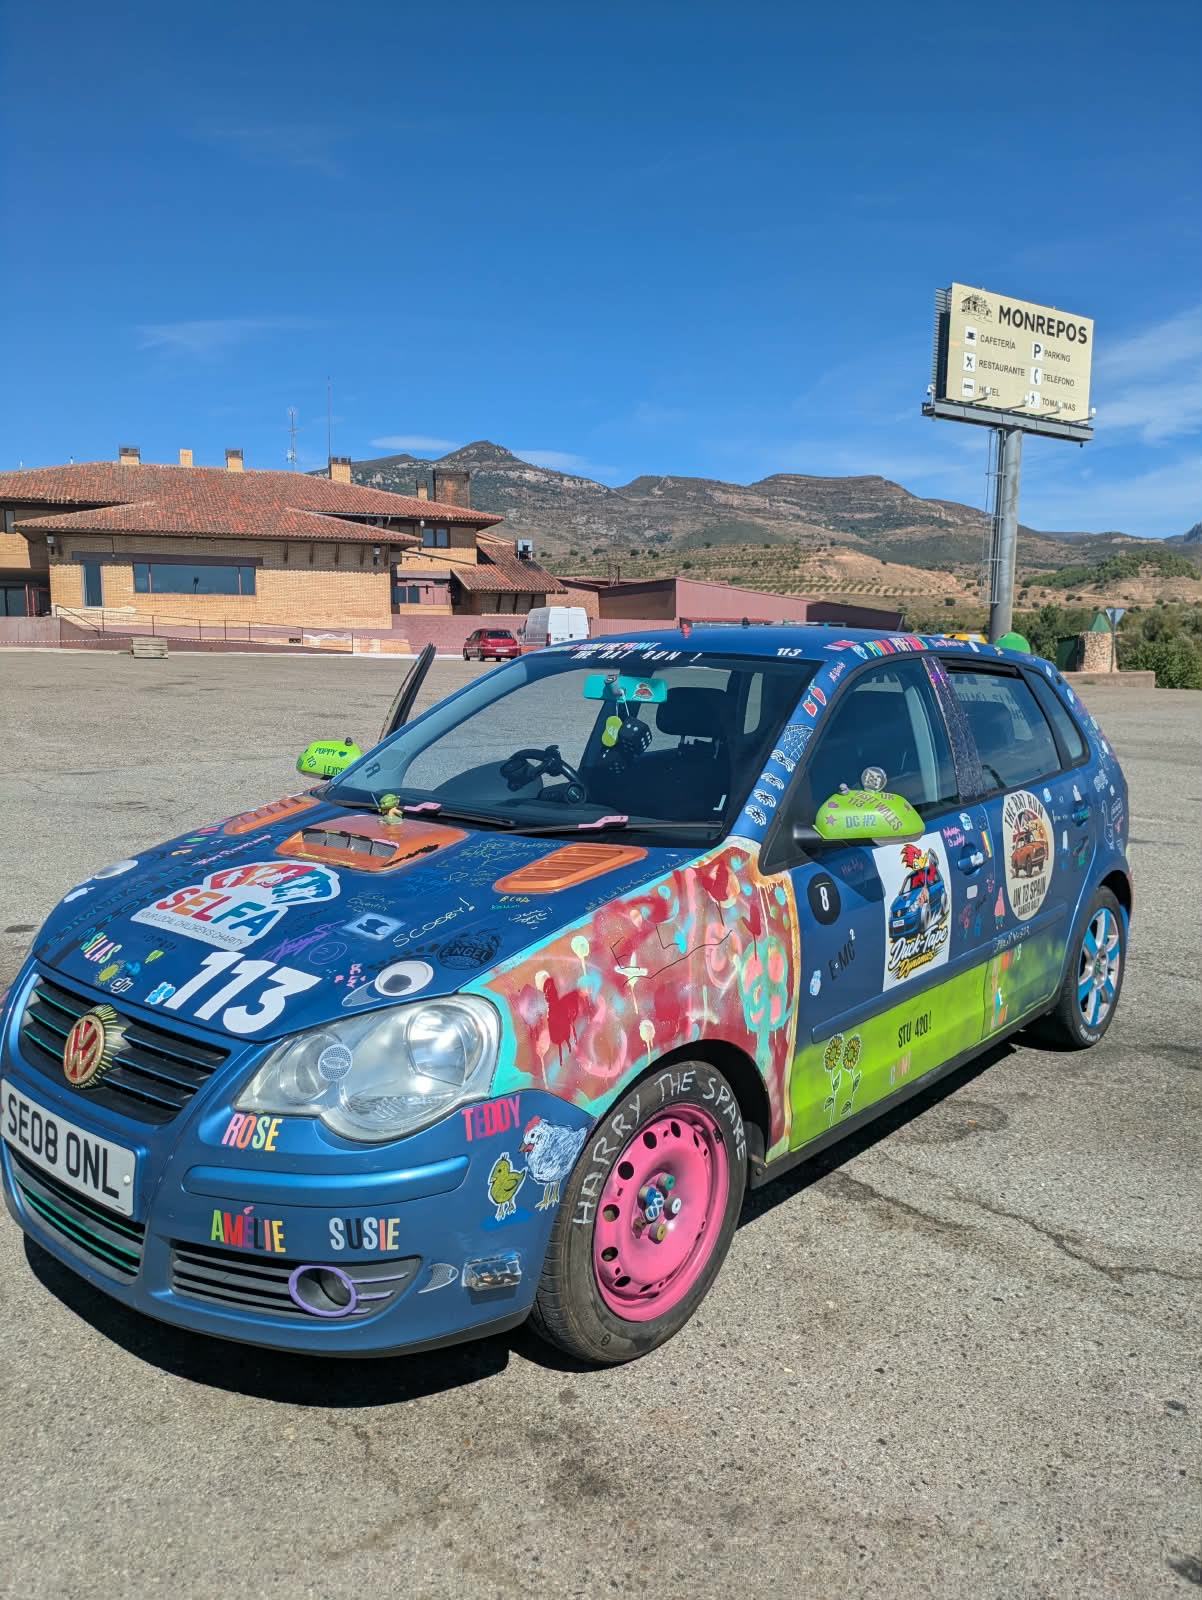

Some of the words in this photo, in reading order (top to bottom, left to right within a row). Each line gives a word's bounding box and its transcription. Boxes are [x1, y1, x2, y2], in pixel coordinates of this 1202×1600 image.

[998, 305, 1088, 345] MONREPOS
[980, 334, 1016, 350] CAFETERÍA
[1044, 349, 1071, 363] PARKING
[978, 359, 1025, 377] RESTAURANTE
[978, 385, 1001, 397] HTEL
[640, 650, 683, 662] RUN
[776, 647, 802, 657] 113
[306, 756, 317, 768] 113
[315, 747, 337, 757] POPPY
[875, 802, 903, 832] WALES
[1004, 802, 1017, 829] THE
[1026, 794, 1044, 820] RUN
[820, 886, 830, 911] 8
[1030, 875, 1047, 900] SPAIN
[156, 888, 283, 939] SELFA
[80, 931, 123, 964] SILAS
[888, 925, 948, 971] Duck-Tape
[896, 950, 935, 979] Dynamics
[163, 952, 322, 1034] 113
[898, 1020, 912, 1049] STU
[221, 1112, 284, 1152] ROSE
[461, 1095, 522, 1143] TEDDY
[8, 1093, 59, 1166] SE08
[65, 1131, 120, 1200] ONL
[572, 1093, 642, 1225] HARRY
[653, 1070, 697, 1102] THE
[702, 1077, 747, 1162] SPARE
[210, 1206, 287, 1254] AMÉLIE
[328, 1216, 401, 1252] SUSIE
